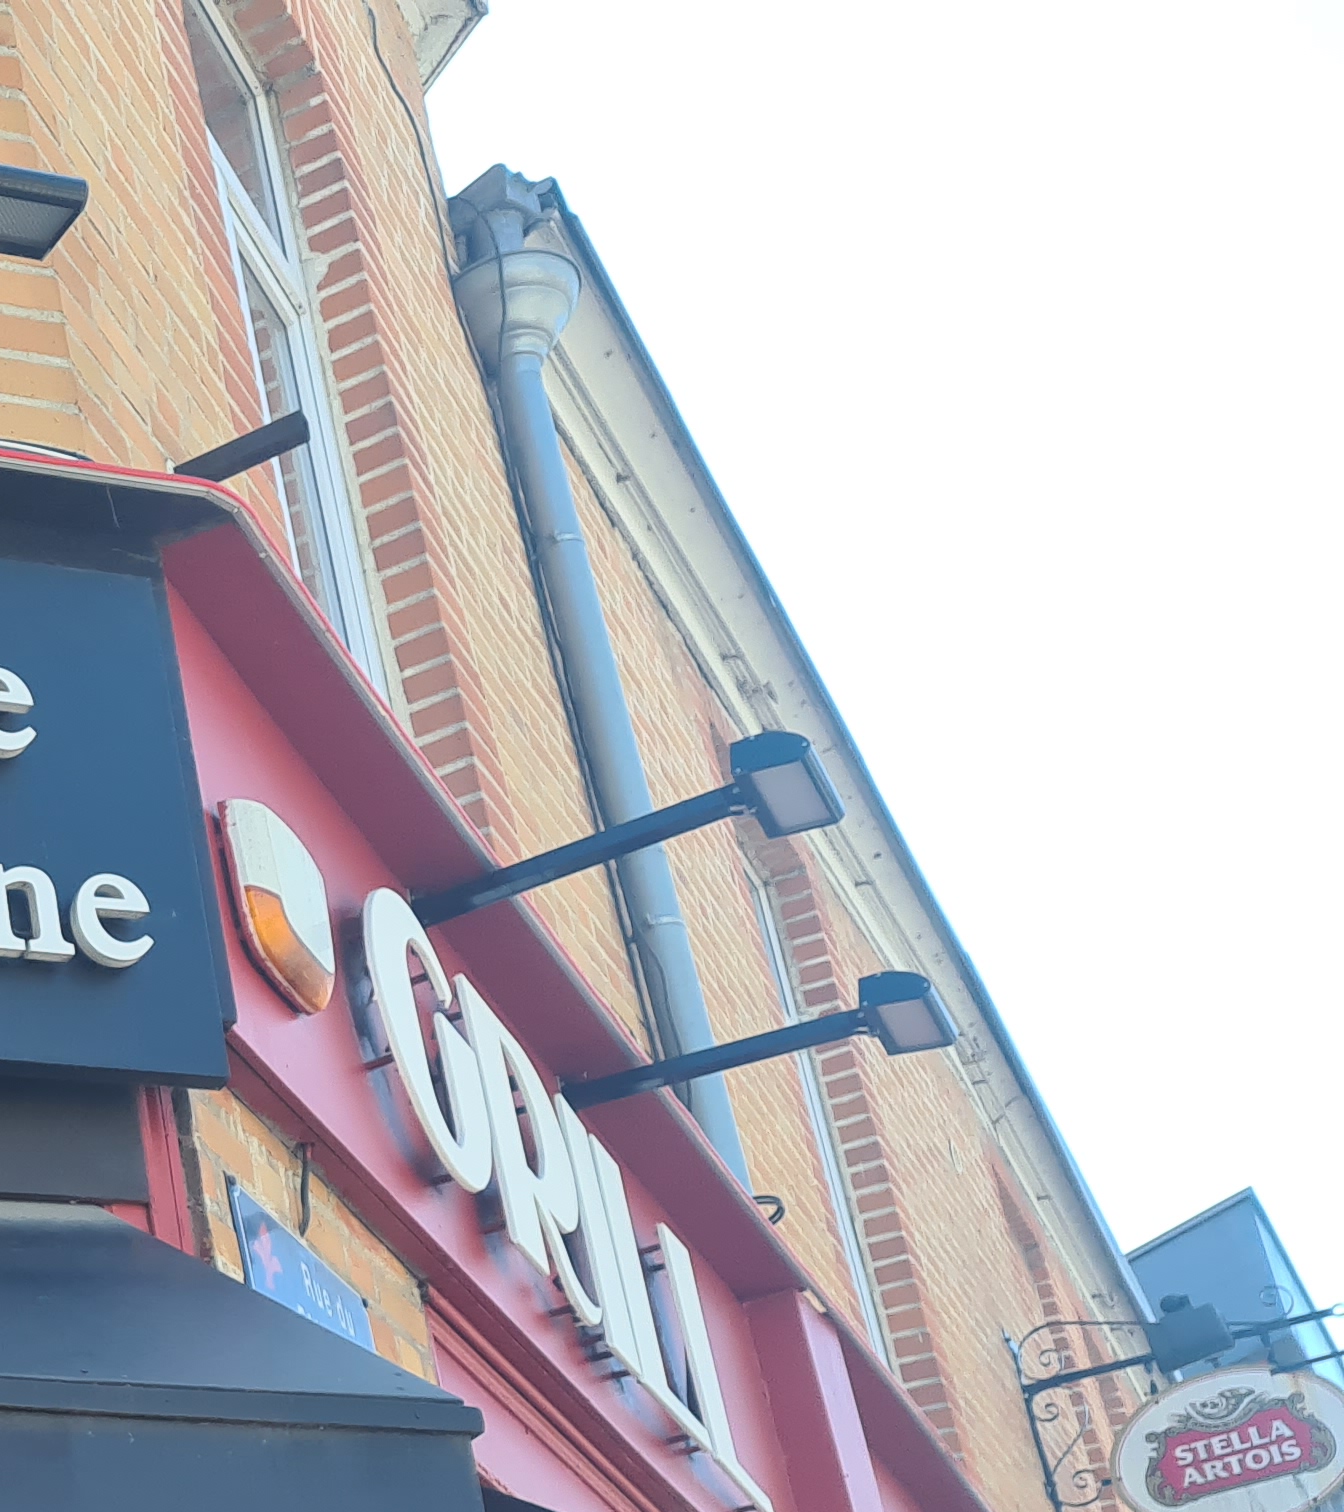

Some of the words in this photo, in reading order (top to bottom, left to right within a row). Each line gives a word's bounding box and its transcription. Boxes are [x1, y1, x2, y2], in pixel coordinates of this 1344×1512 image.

[300, 1261, 334, 1317] Rue
[336, 1296, 356, 1338] du
[1174, 1420, 1295, 1466] STELLA
[1183, 1439, 1302, 1488] ARTOIS
